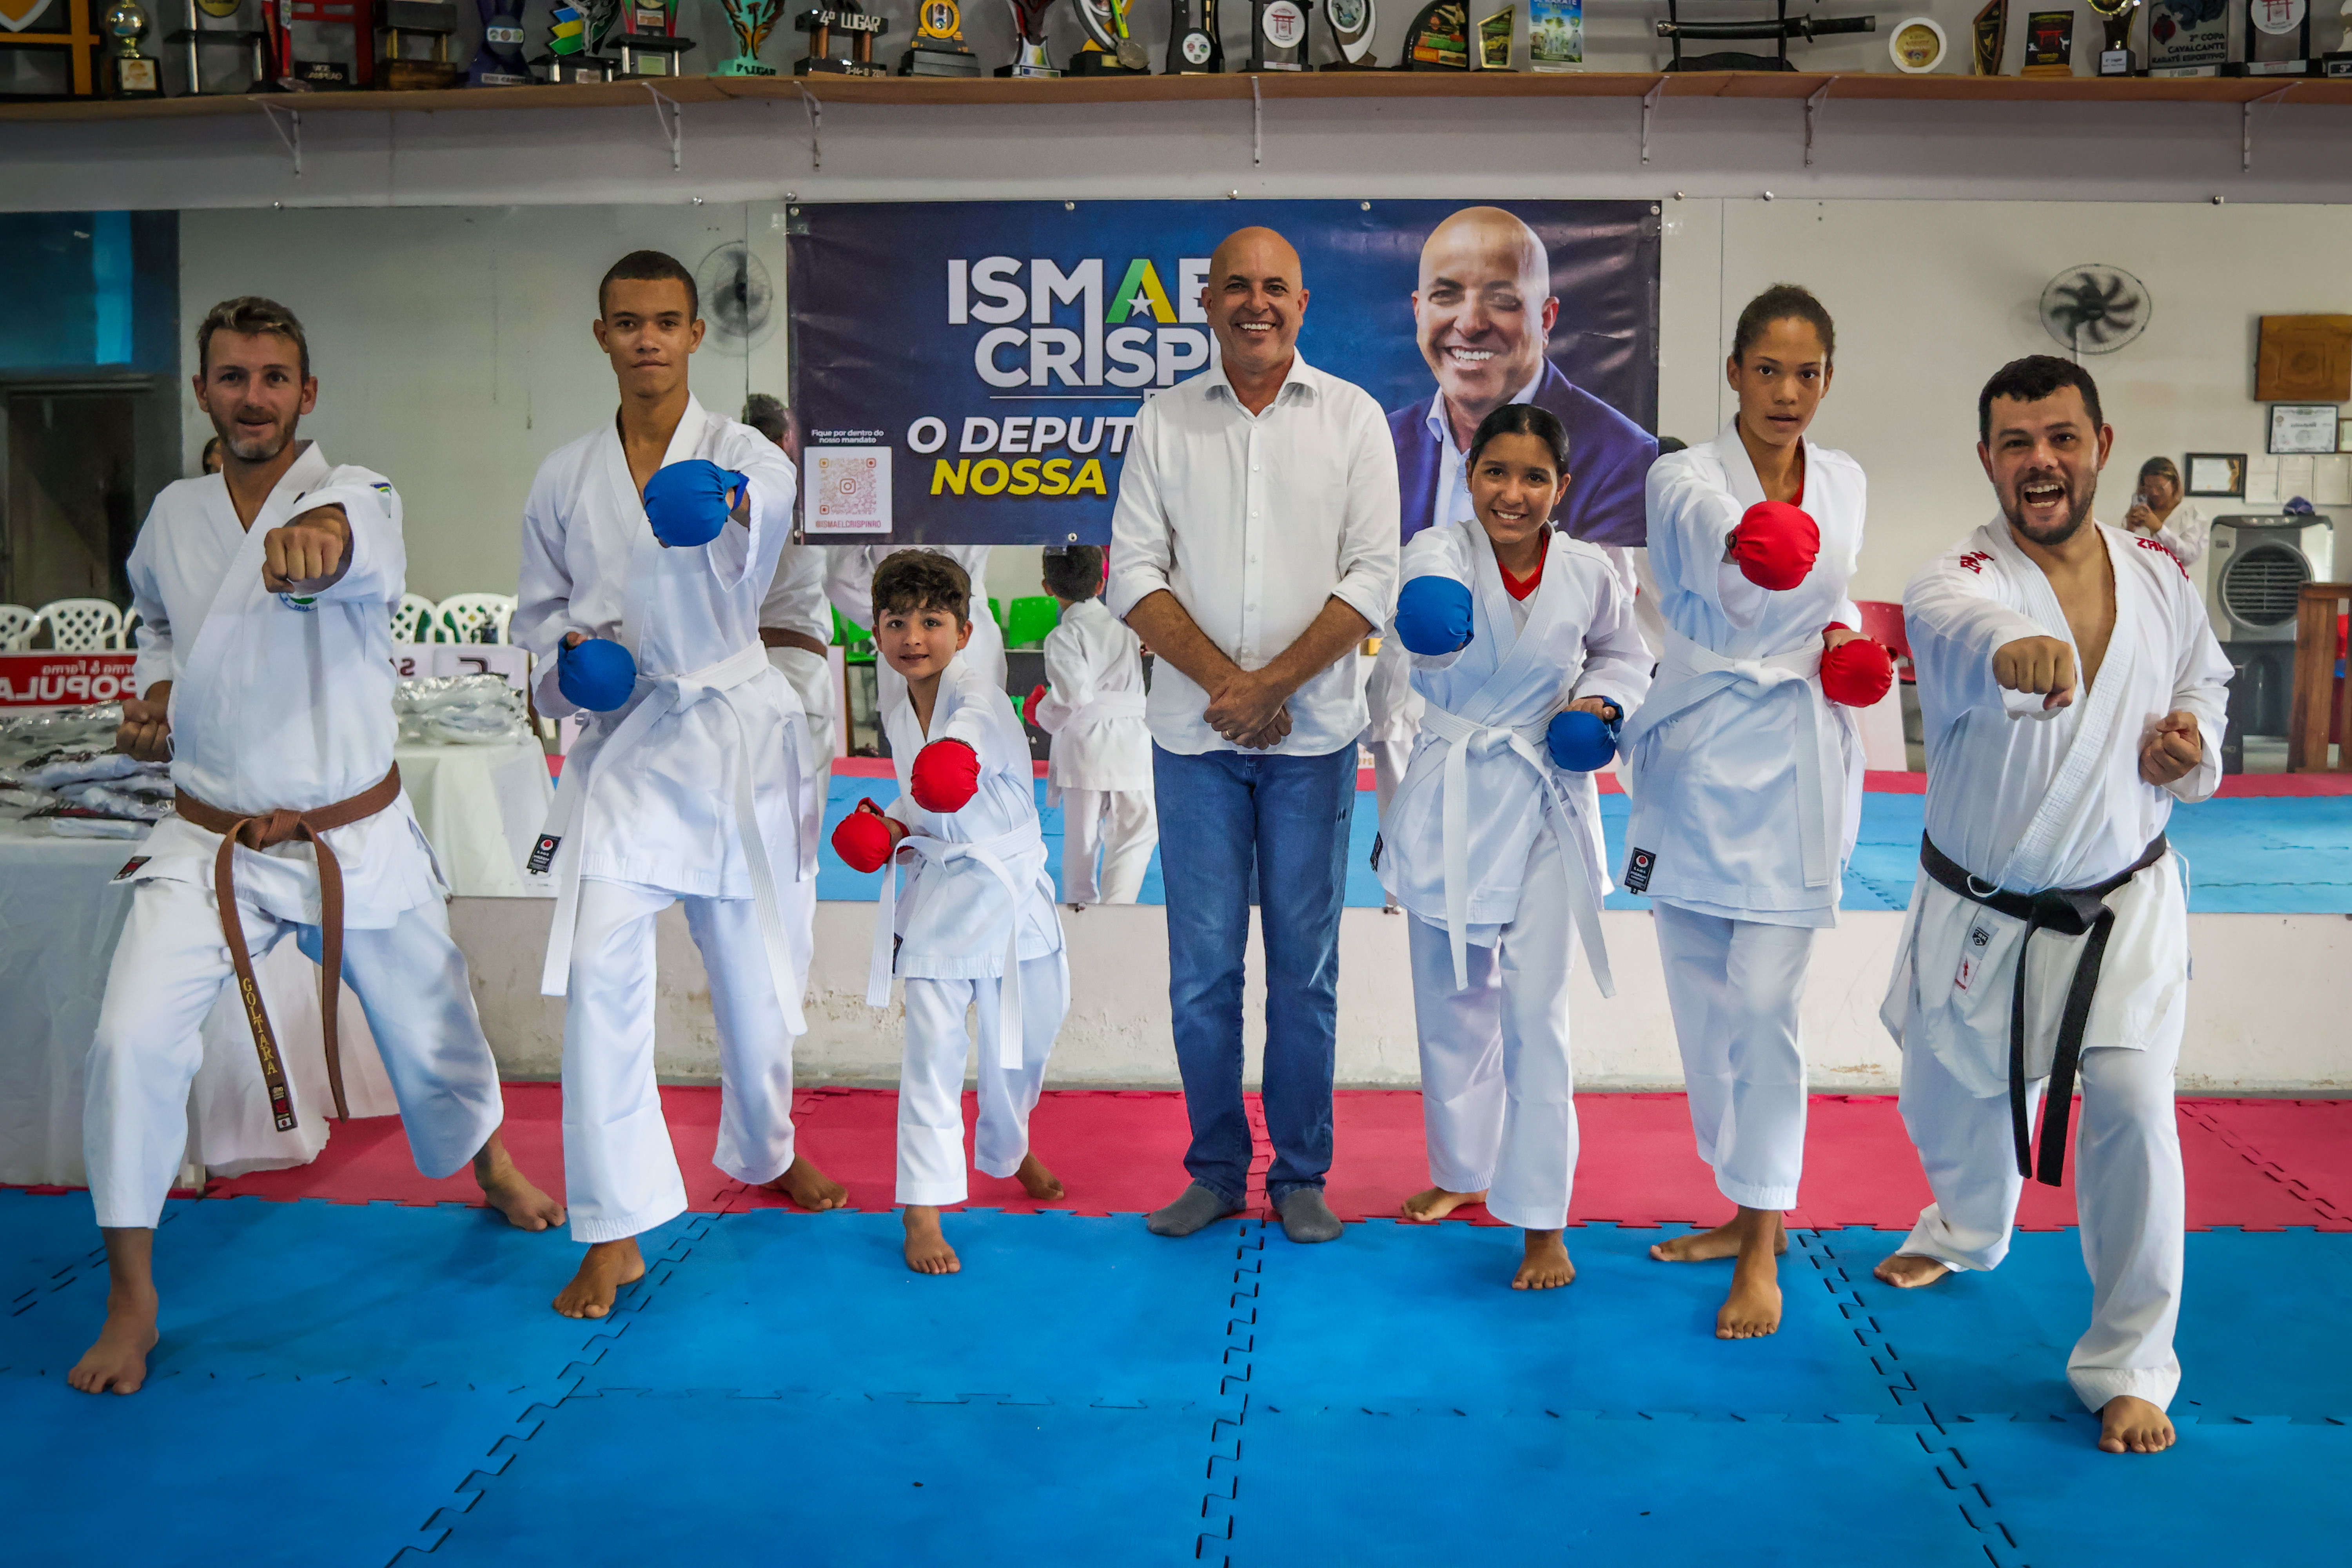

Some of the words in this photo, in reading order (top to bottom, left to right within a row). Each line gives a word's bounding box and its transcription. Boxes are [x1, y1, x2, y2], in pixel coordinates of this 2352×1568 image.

[841, 12, 882, 33] LUGAR
[947, 256, 1212, 325] ISMAE
[974, 327, 1221, 388] CRISP
[811, 429, 833, 437] Fique
[906, 416, 947, 454] O
[958, 416, 1136, 454] DEPUT
[930, 457, 1107, 495] NOSSA
[242, 977, 278, 1075] GOLTARA
